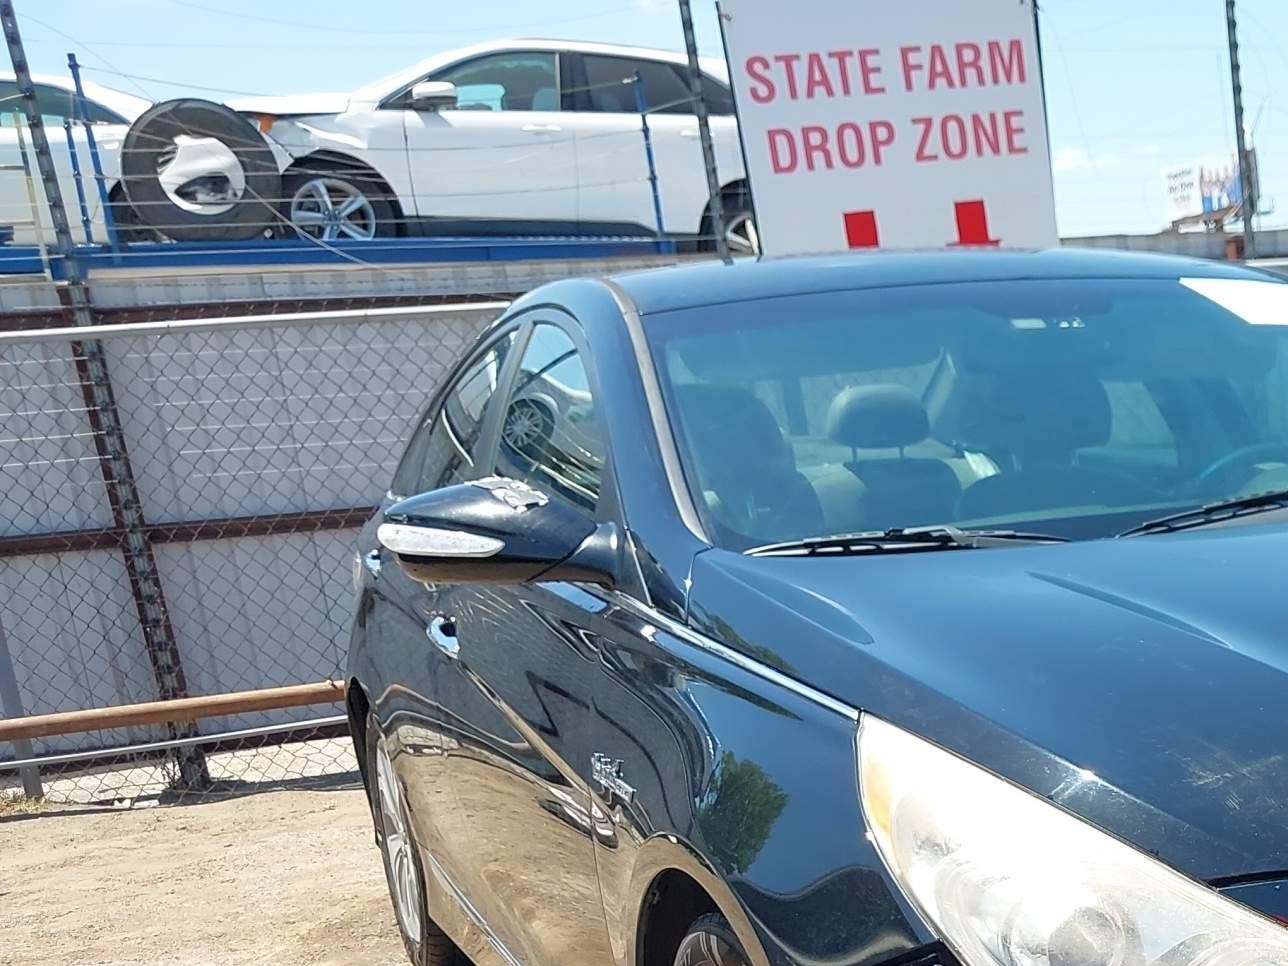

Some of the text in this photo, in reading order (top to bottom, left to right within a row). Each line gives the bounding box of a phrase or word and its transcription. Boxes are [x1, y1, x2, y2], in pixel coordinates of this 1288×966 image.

[745, 39, 1027, 104] STATE FARM
[767, 110, 1029, 174] DROP ZONE
